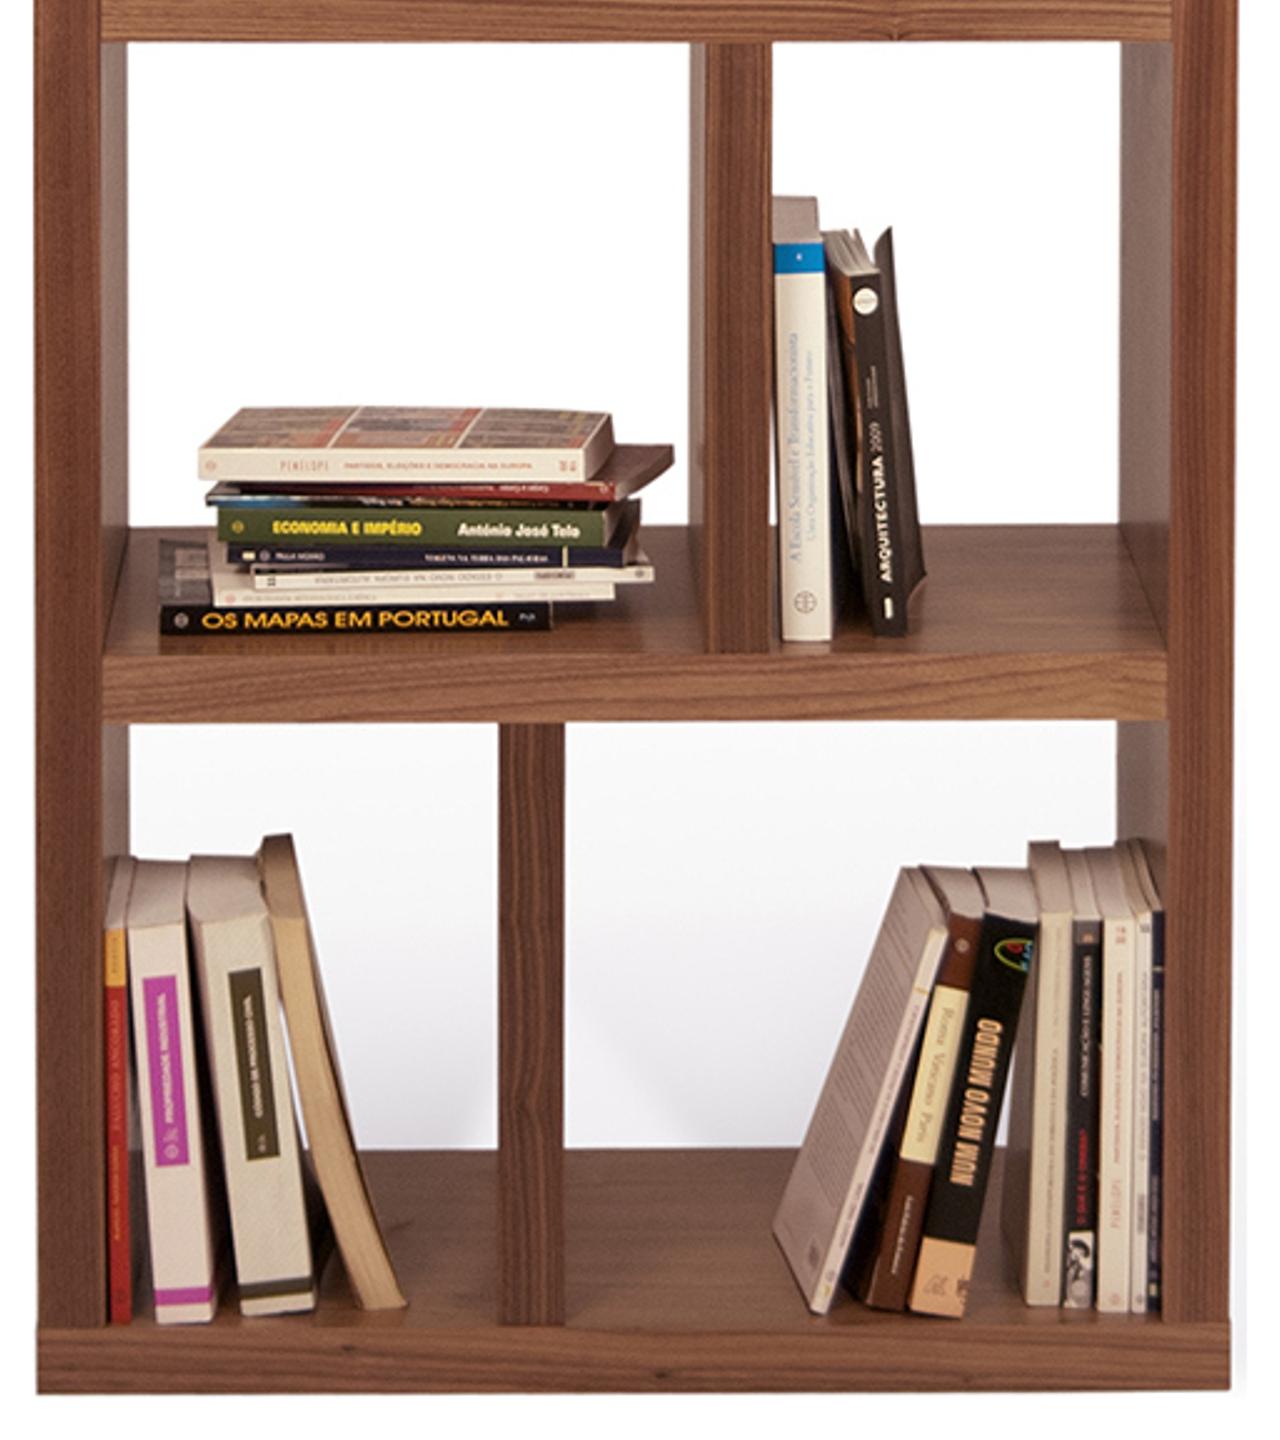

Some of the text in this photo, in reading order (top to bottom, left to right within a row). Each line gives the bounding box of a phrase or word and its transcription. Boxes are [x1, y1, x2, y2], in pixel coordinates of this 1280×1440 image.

[868, 421, 882, 452] 2009
[271, 518, 422, 536] ECONOMIA E IMPÉRIO
[457, 521, 512, 536] António
[514, 522, 549, 537] José
[789, 512, 800, 549] Escola
[871, 455, 894, 583] ARQUITECTURA
[790, 552, 801, 562] A
[201, 611, 237, 629] OS
[243, 611, 327, 628] MAPAS
[334, 611, 372, 627] EM
[378, 610, 509, 628] PORTUGAL
[937, 1006, 954, 1046] Roma
[950, 1018, 1001, 1186] NUM NOVO MUNDO
